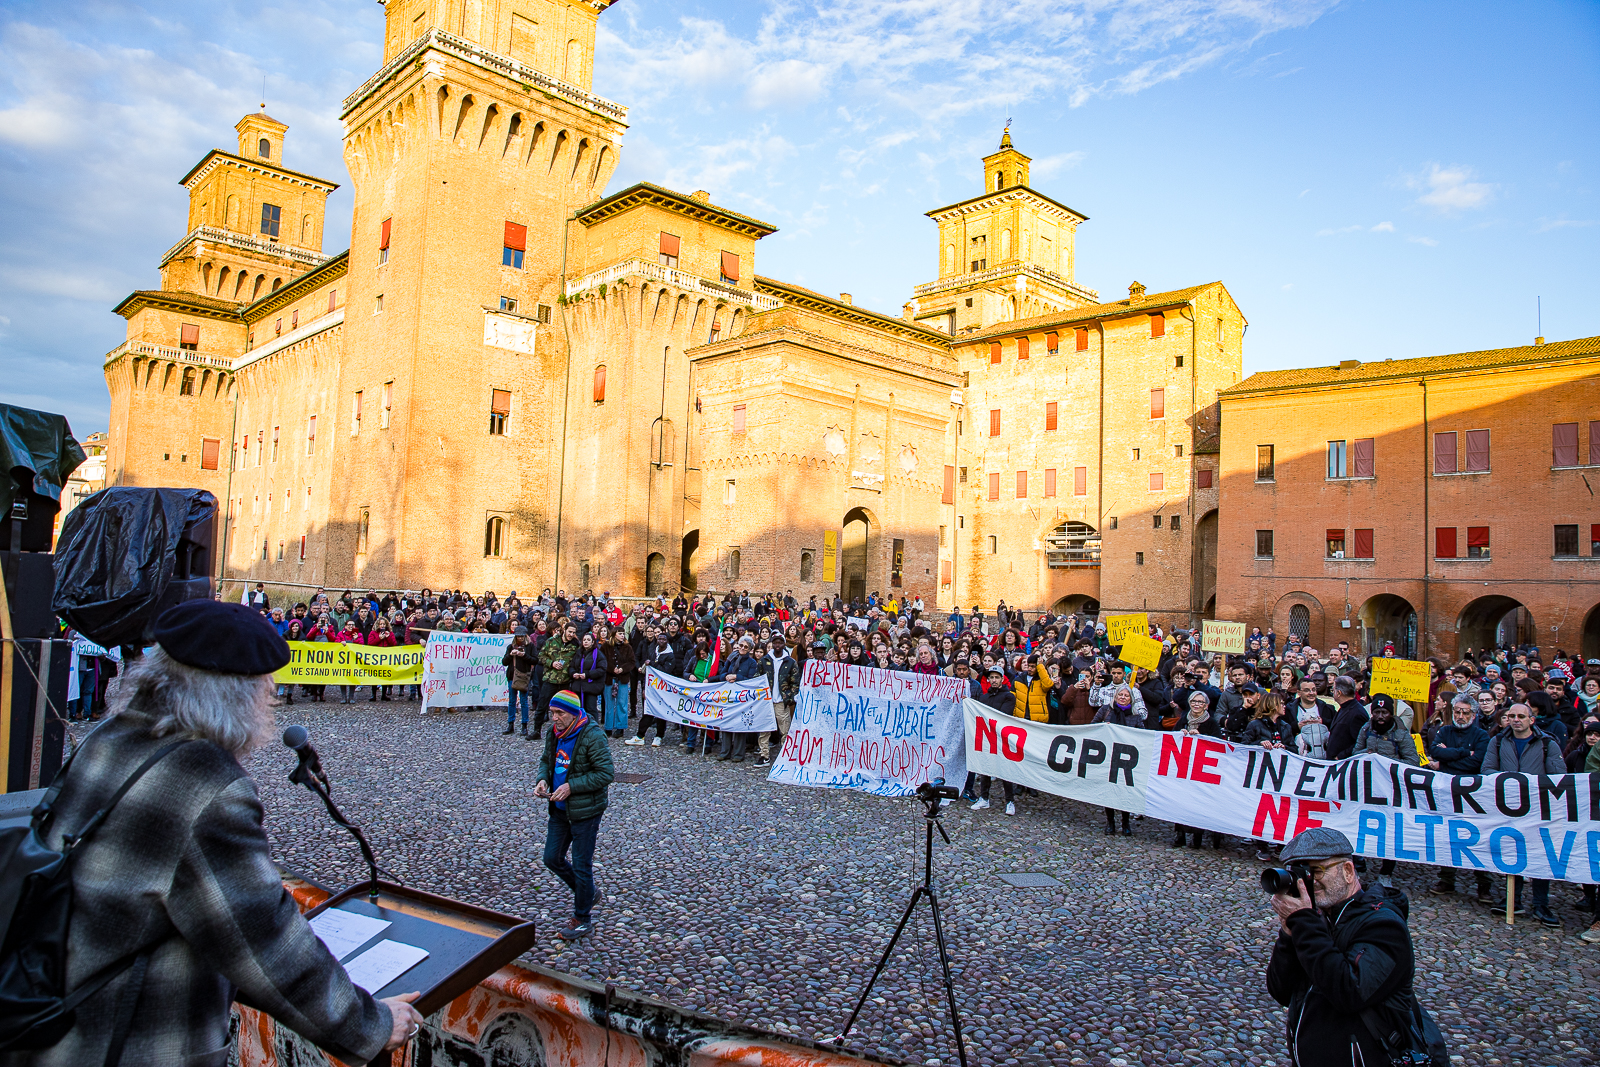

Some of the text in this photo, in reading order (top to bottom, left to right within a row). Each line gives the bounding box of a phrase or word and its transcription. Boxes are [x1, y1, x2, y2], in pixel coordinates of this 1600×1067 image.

[306, 650, 334, 664] NON
[338, 651, 350, 665] SI
[434, 644, 473, 660] PENNY
[456, 664, 506, 679] BOLOGNA
[1372, 658, 1427, 671] NO LAGER
[290, 667, 392, 678] WE STAND WITH REFUGEES
[905, 679, 913, 691] DE
[1380, 676, 1401, 685] ITALIA
[694, 686, 772, 704] ACCOGLIENTI
[1393, 686, 1422, 696] ALBANIA
[677, 698, 724, 720] BOLOGNA
[821, 701, 833, 717] LA
[835, 692, 870, 733] PAIX
[867, 706, 879, 718] ET
[882, 700, 937, 741] LIBERTÉ
[829, 732, 855, 774] HAS
[859, 739, 879, 771] NO
[974, 715, 1028, 762] NO
[1046, 735, 1140, 787] CPR
[1243, 750, 1287, 794] IN
[1293, 757, 1437, 813] EMILIA
